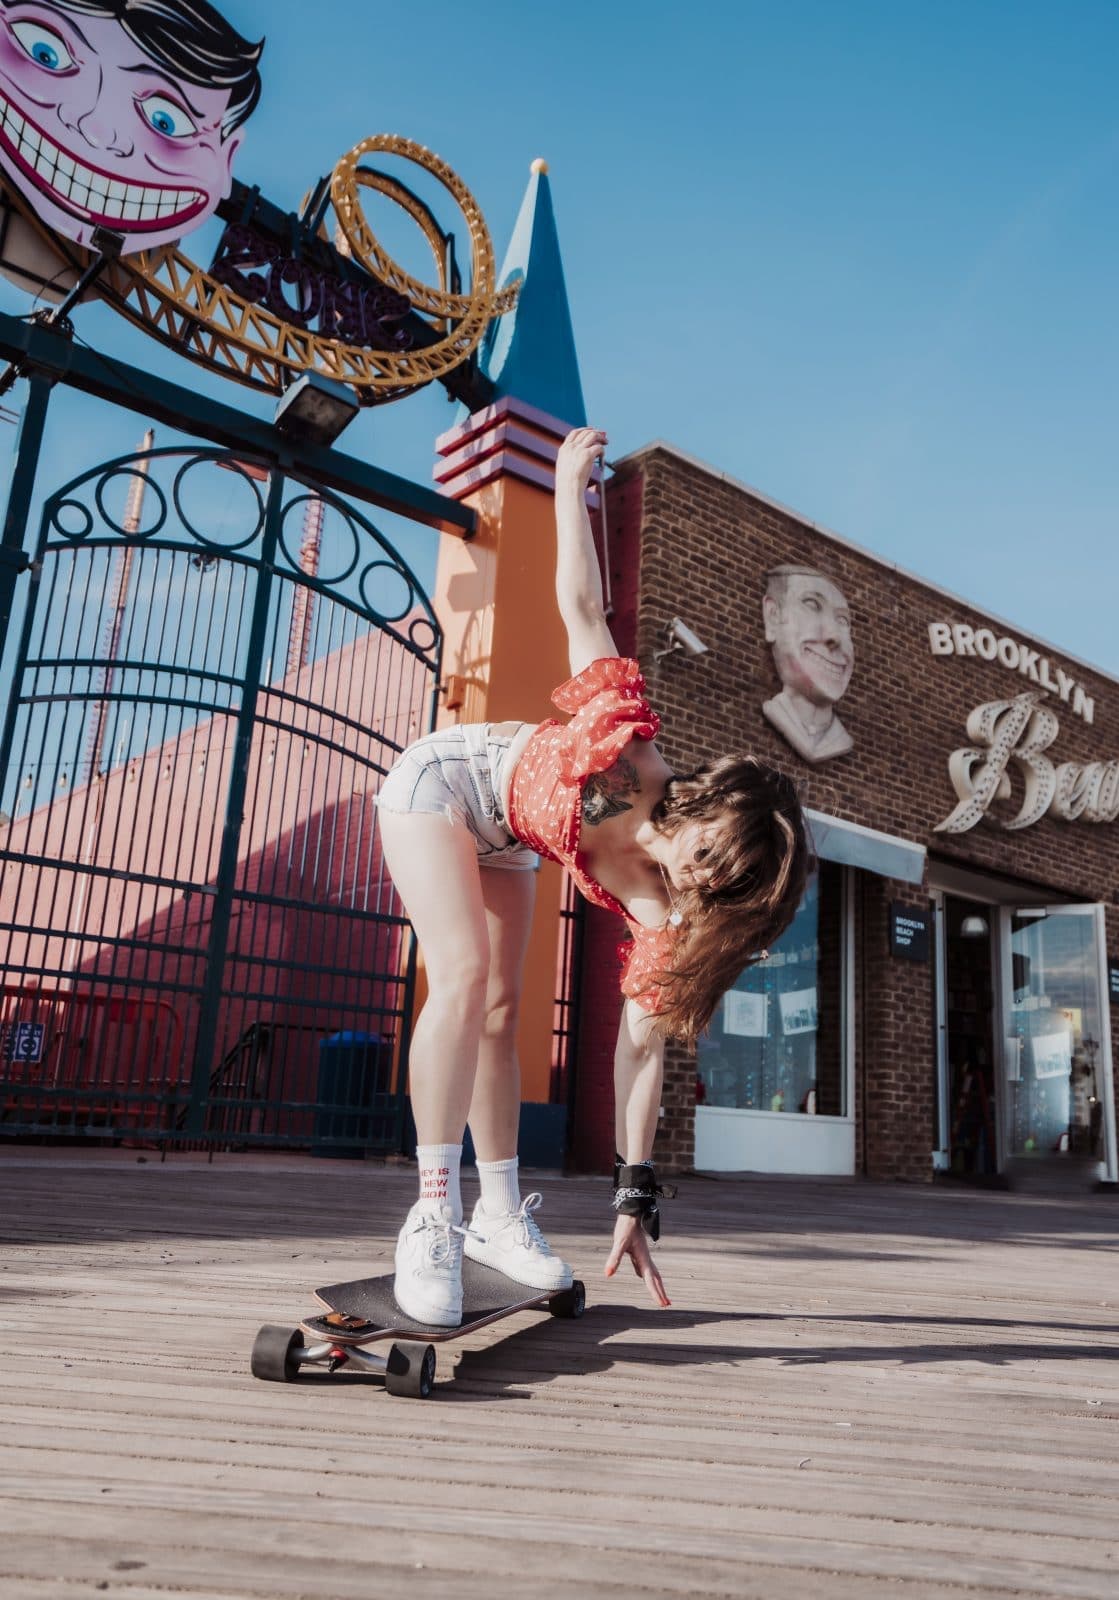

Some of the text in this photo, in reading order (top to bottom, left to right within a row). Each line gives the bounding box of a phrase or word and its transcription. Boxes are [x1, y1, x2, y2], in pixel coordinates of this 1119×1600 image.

[928, 622, 1095, 725] BROOKLYN
[896, 916, 925, 930] BROOKLYN
[896, 926, 914, 936] BEACH
[896, 935, 912, 945] SHOP
[438, 1167, 450, 1176] IS
[424, 1178, 448, 1188] NEW
